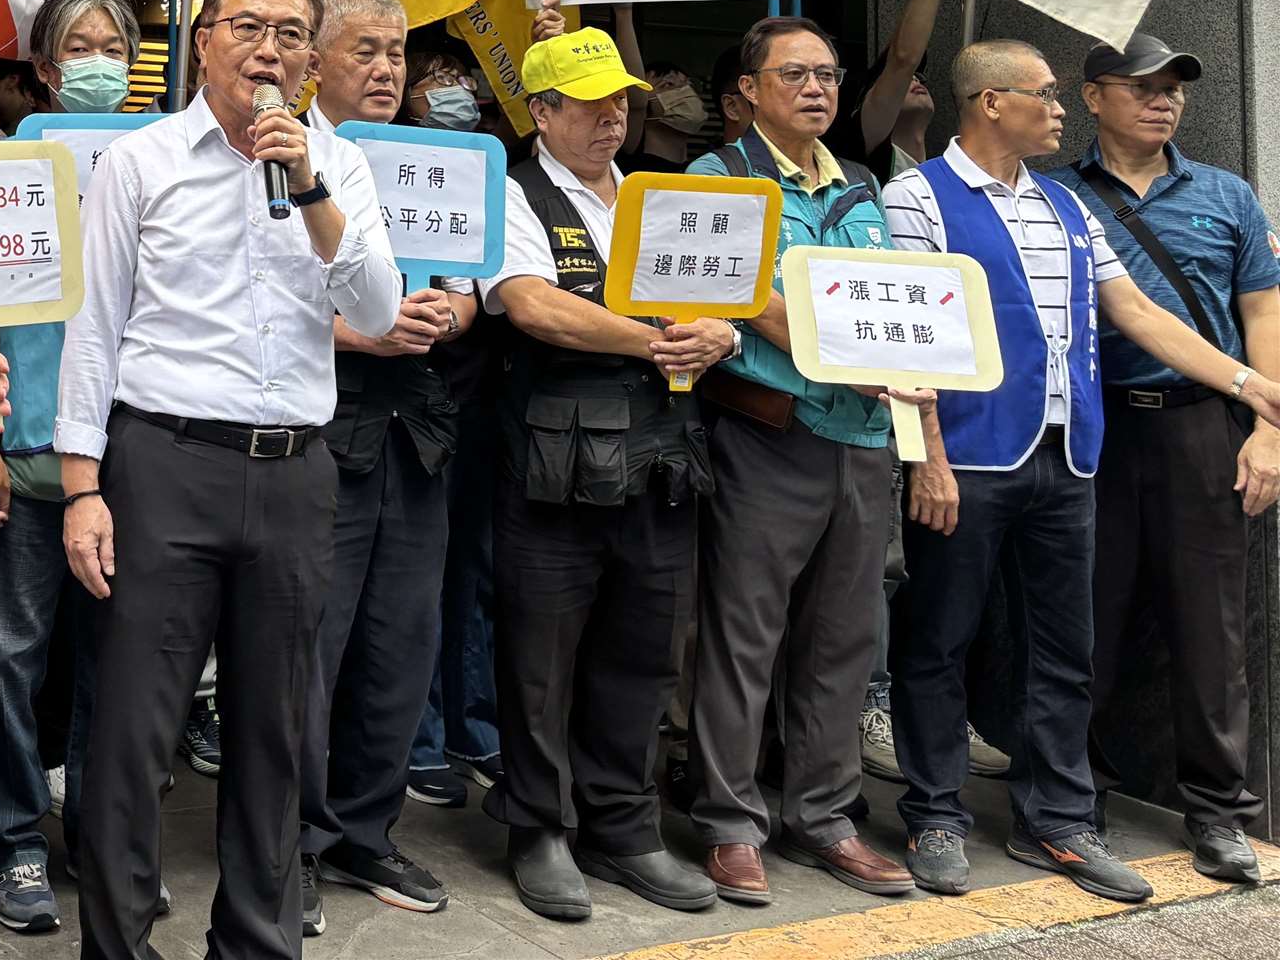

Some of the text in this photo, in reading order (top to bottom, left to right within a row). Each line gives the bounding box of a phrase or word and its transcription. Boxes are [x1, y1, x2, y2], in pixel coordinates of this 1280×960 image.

[489, 42, 526, 97] UNION
[397, 162, 446, 189] 所得
[26, 183, 45, 208] 元
[679, 211, 729, 235] 照顧
[31, 230, 51, 256] 元
[653, 253, 744, 279] 邊際勞工
[848, 279, 929, 306] 漲工資
[853, 320, 936, 346] 抗通膨
